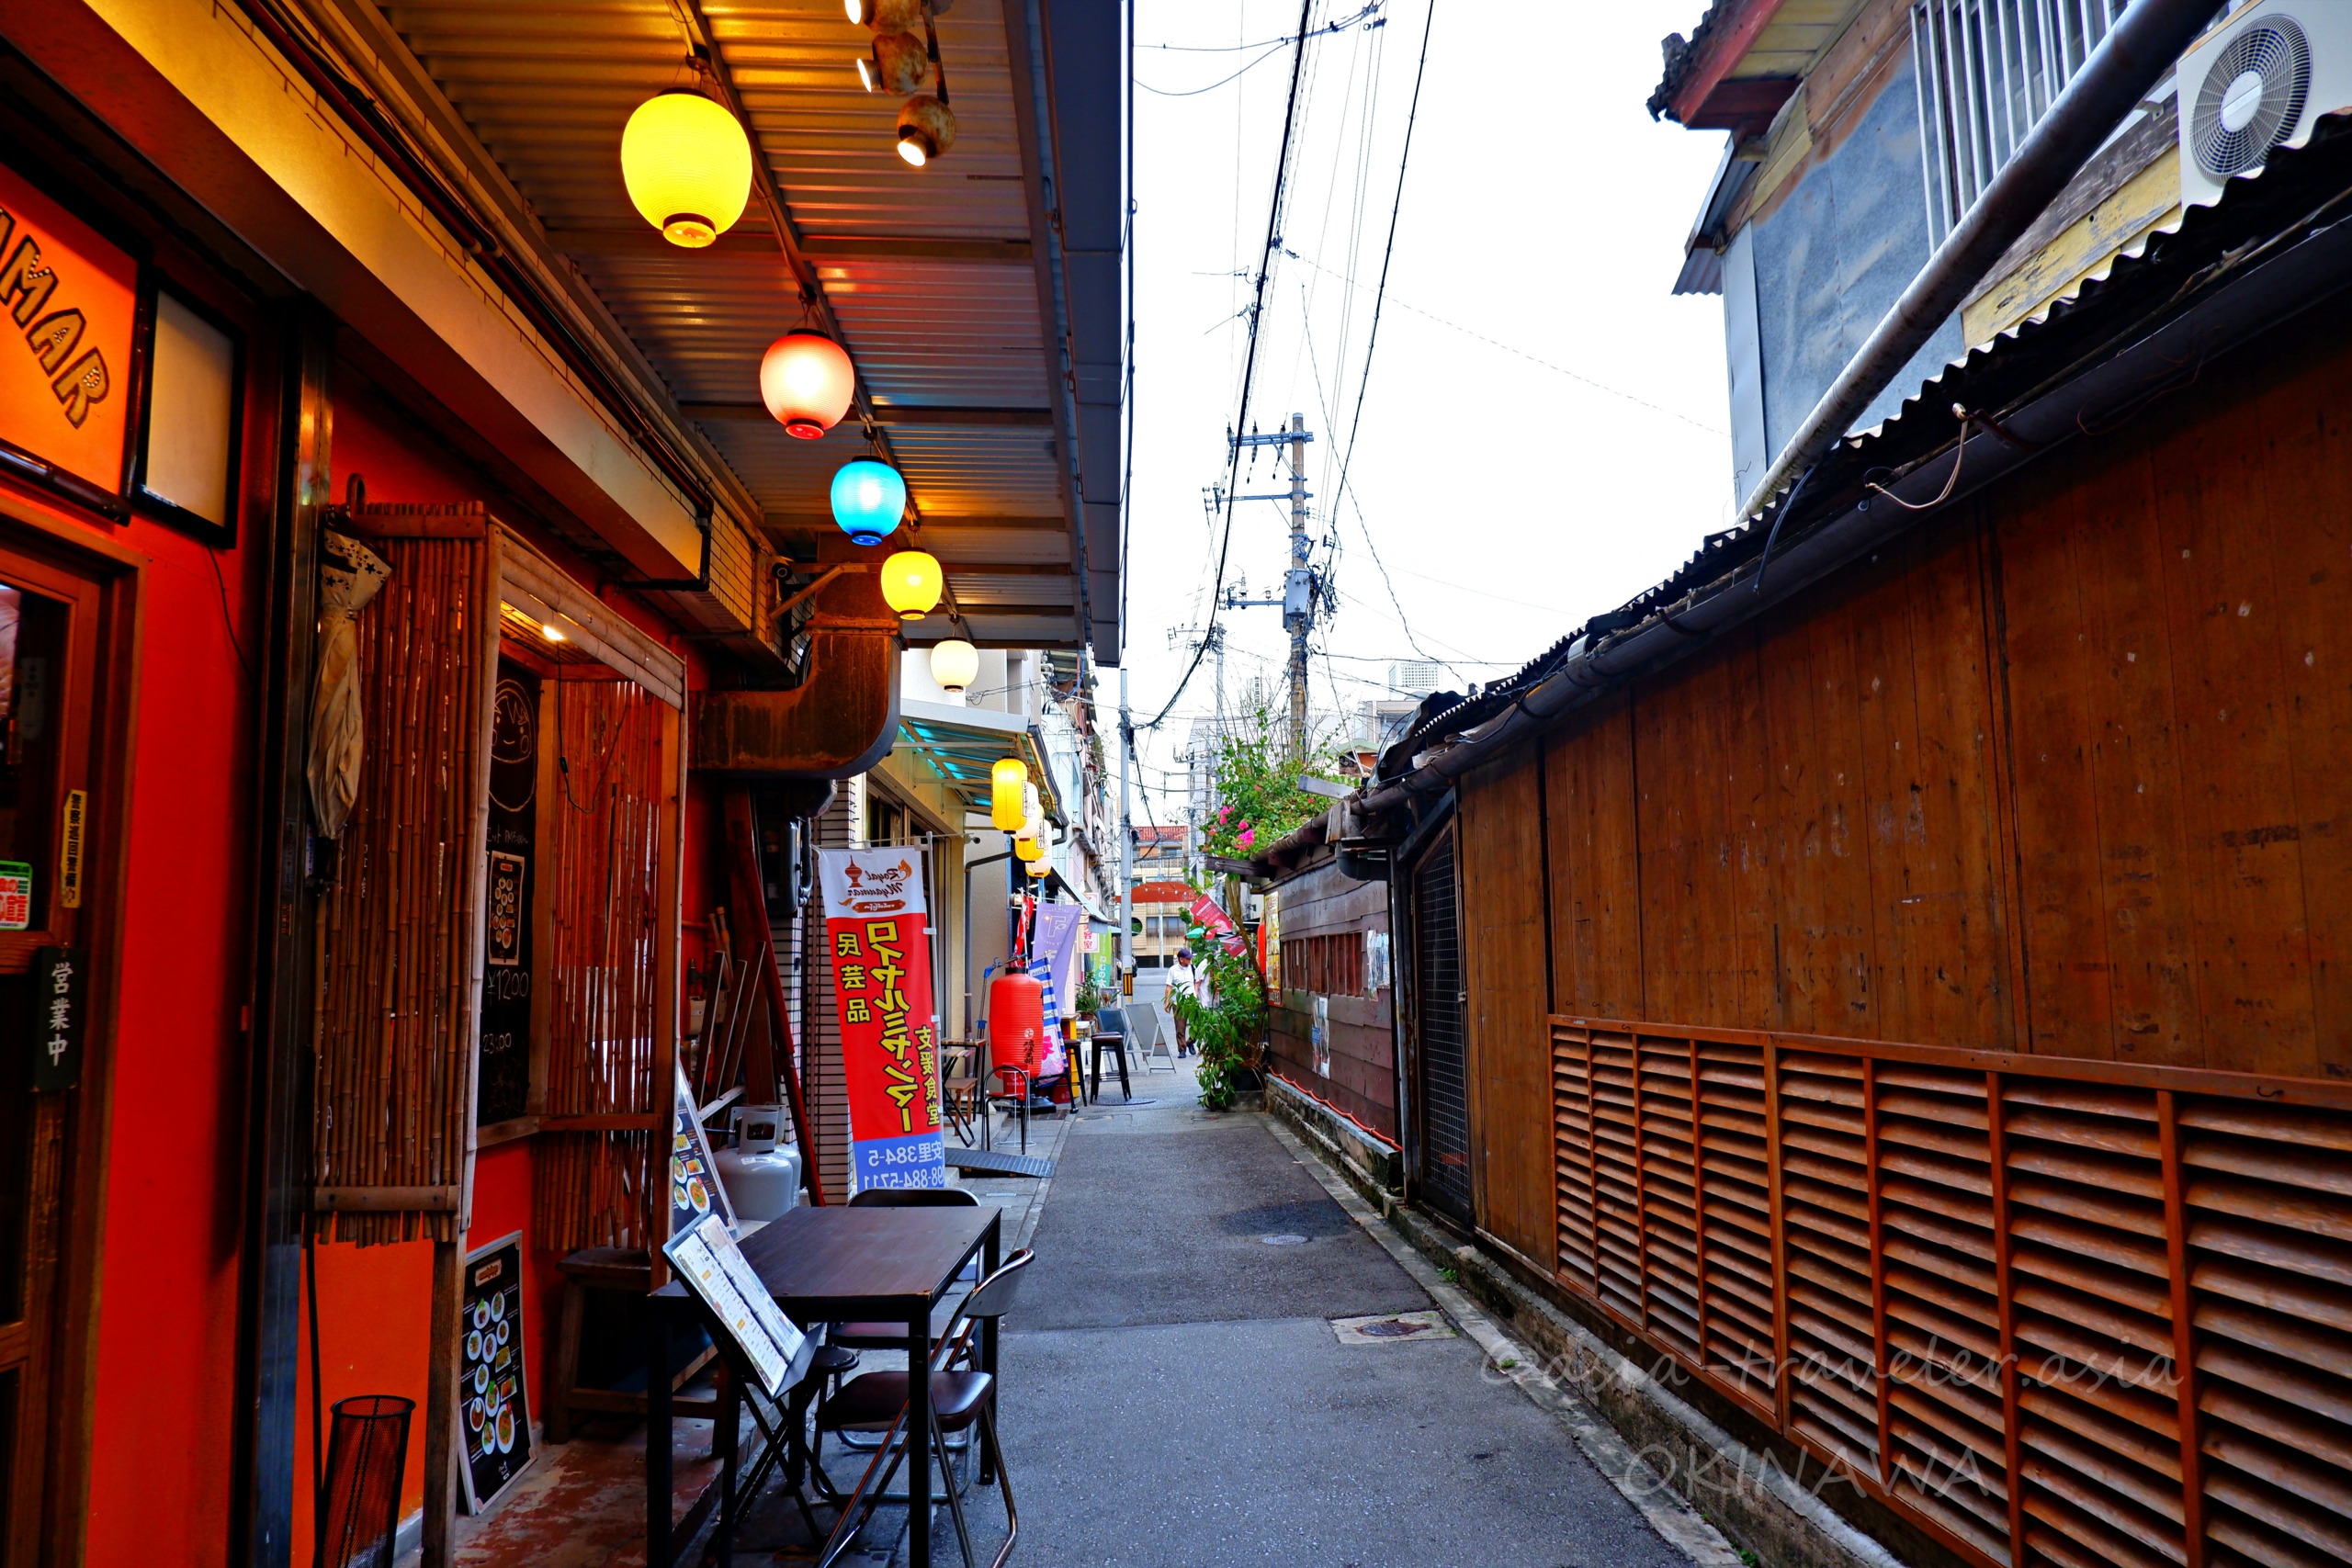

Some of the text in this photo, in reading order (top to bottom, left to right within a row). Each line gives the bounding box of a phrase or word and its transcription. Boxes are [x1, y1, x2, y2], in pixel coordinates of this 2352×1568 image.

[0, 204, 109, 429] MAR
[46, 962, 74, 1066] 営業中
[487, 968, 529, 1007] ¥1200
